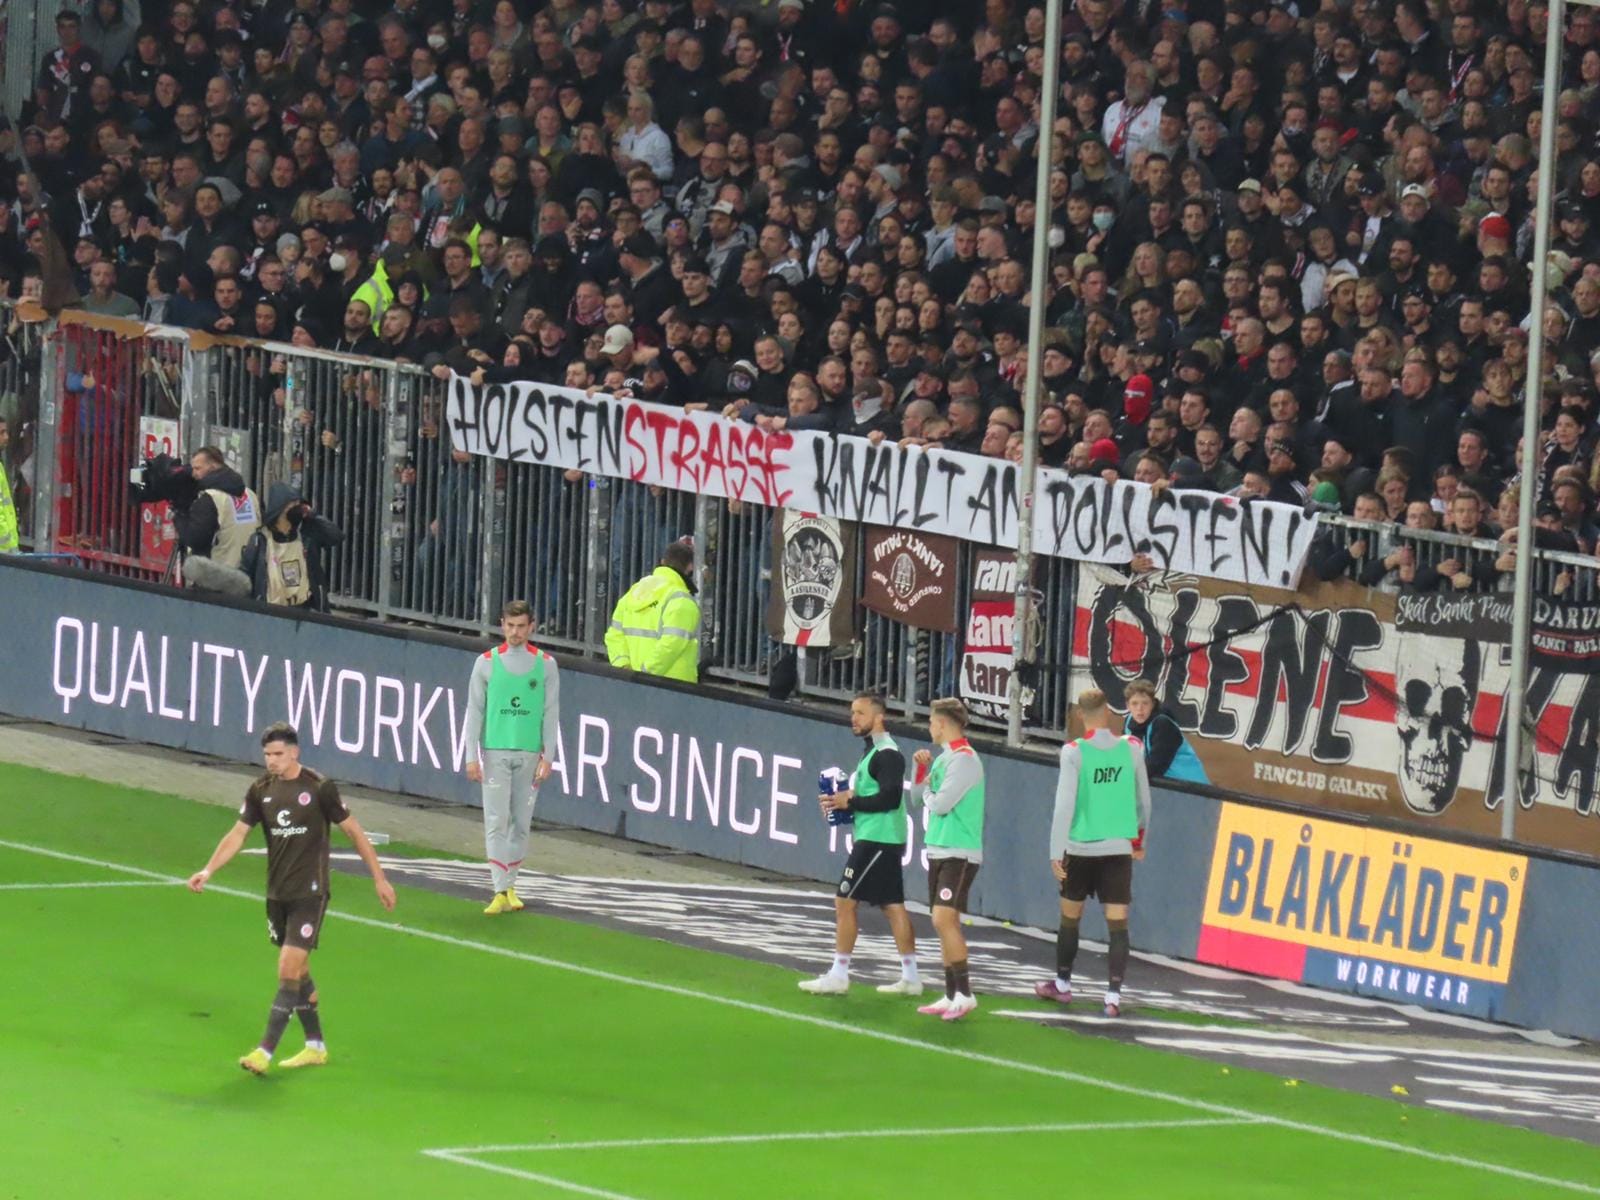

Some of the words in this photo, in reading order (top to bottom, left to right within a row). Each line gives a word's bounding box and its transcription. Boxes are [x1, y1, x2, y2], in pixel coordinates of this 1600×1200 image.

[814, 435, 966, 527] KNALLT
[1532, 598, 1600, 630] DARU
[1574, 639, 1600, 654] PAUL
[53, 616, 269, 733] QUALITY
[285, 659, 610, 804] WORKR
[631, 726, 801, 845] SINCE
[1253, 762, 1327, 791] FANCLUB
[1329, 776, 1389, 801] GALAXY
[1337, 957, 1469, 1005] WORKWEAR
